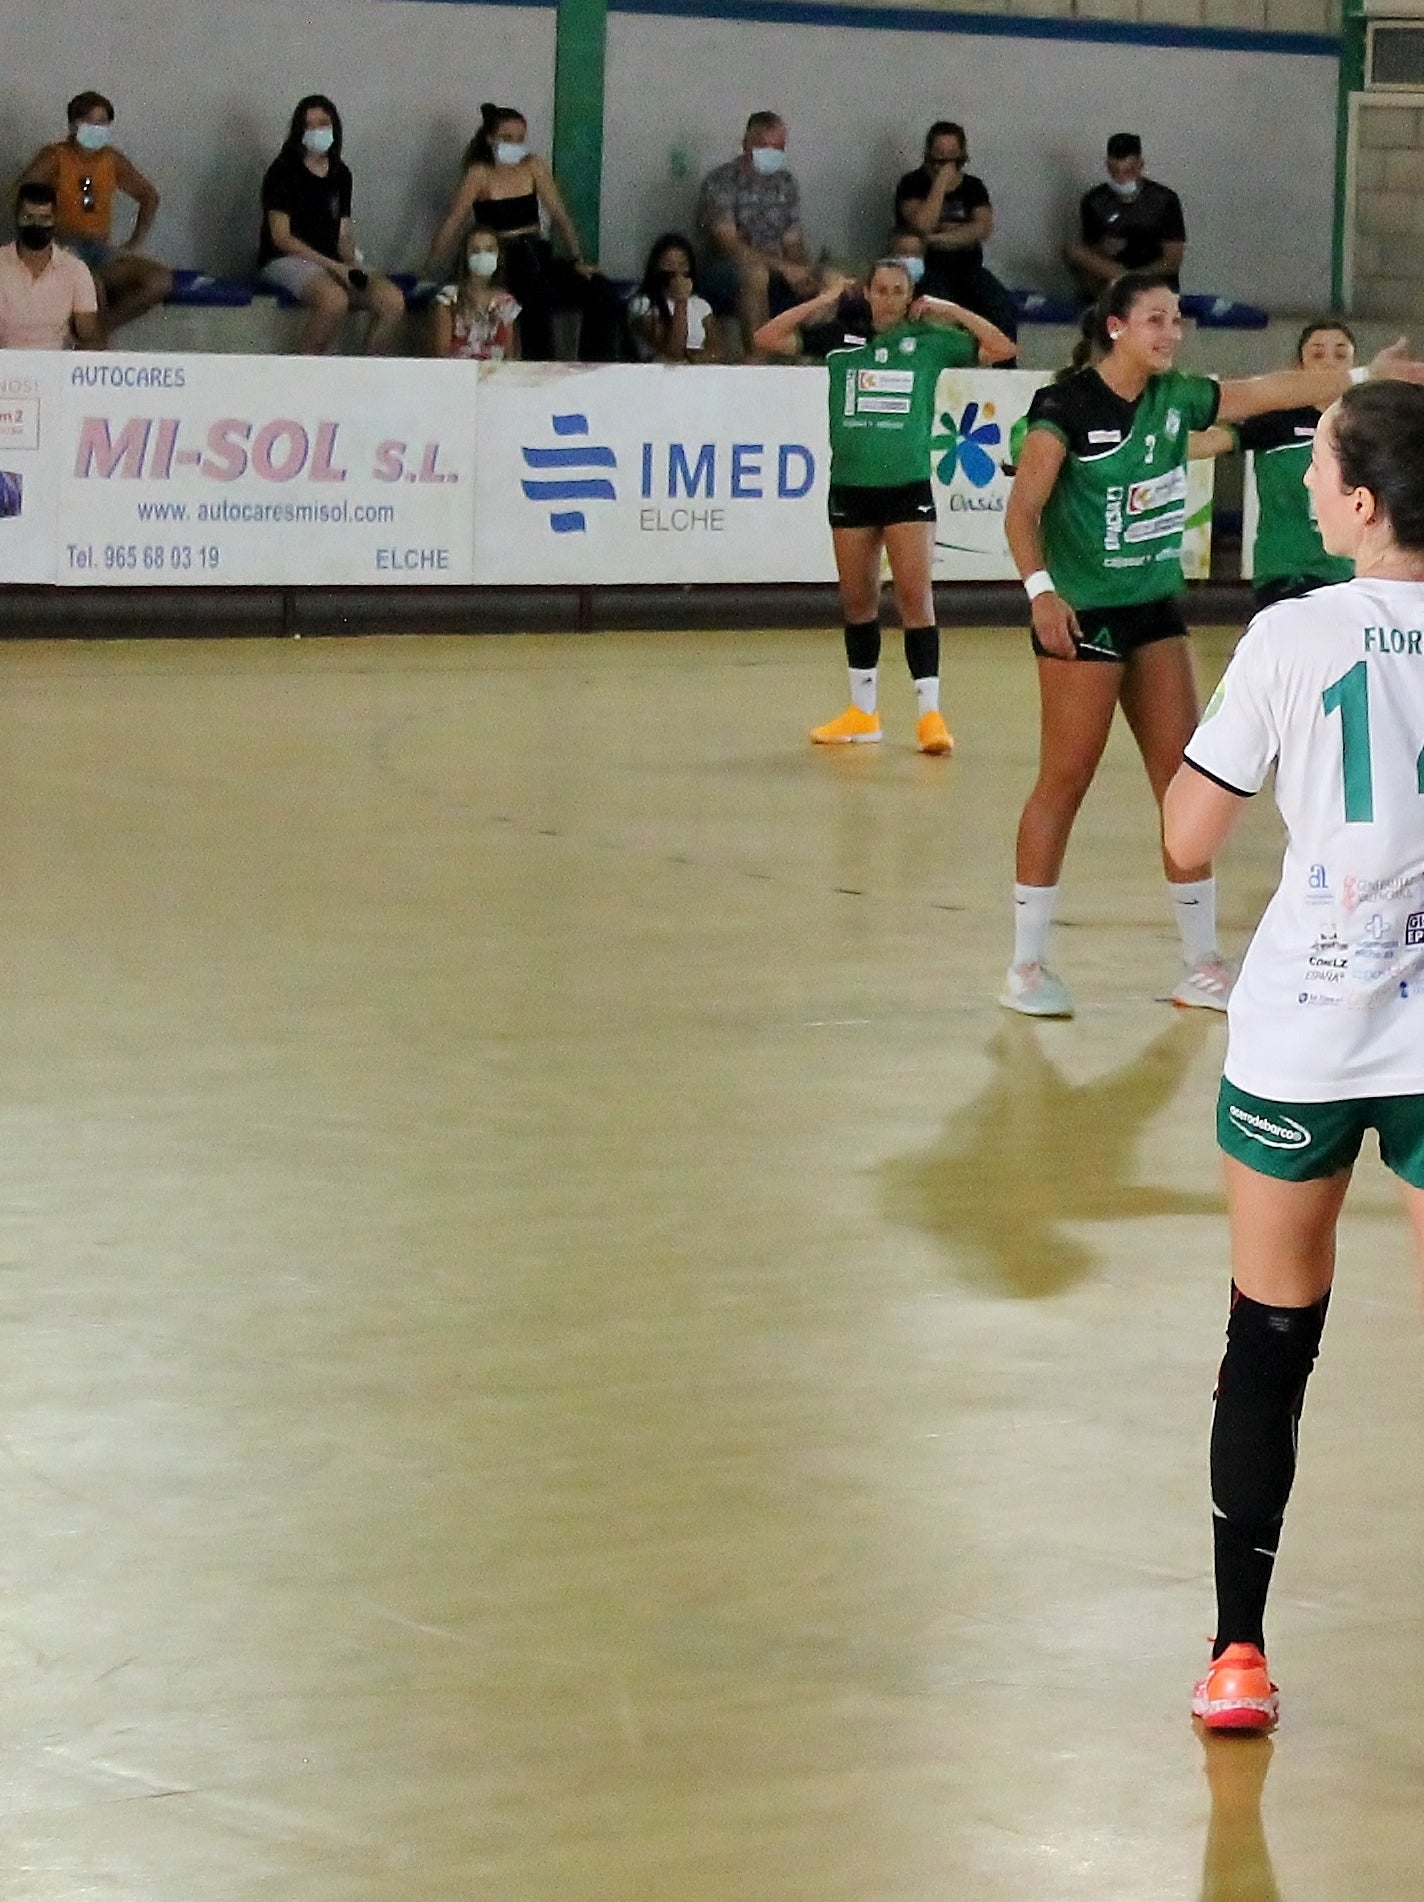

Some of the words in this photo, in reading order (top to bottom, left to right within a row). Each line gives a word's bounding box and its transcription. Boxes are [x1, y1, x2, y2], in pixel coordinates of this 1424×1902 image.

[71, 366, 186, 388] AUTOCARES
[73, 415, 348, 482] MI-SOL
[373, 439, 459, 483] S.L.
[641, 442, 816, 499] IMED
[640, 508, 725, 532] ELCHE
[67, 545, 97, 569] Tel.
[105, 545, 137, 569] 965
[143, 546, 166, 569] 68
[171, 547, 192, 570] 03
[200, 547, 220, 570] 19
[375, 549, 449, 570] ELCHE
